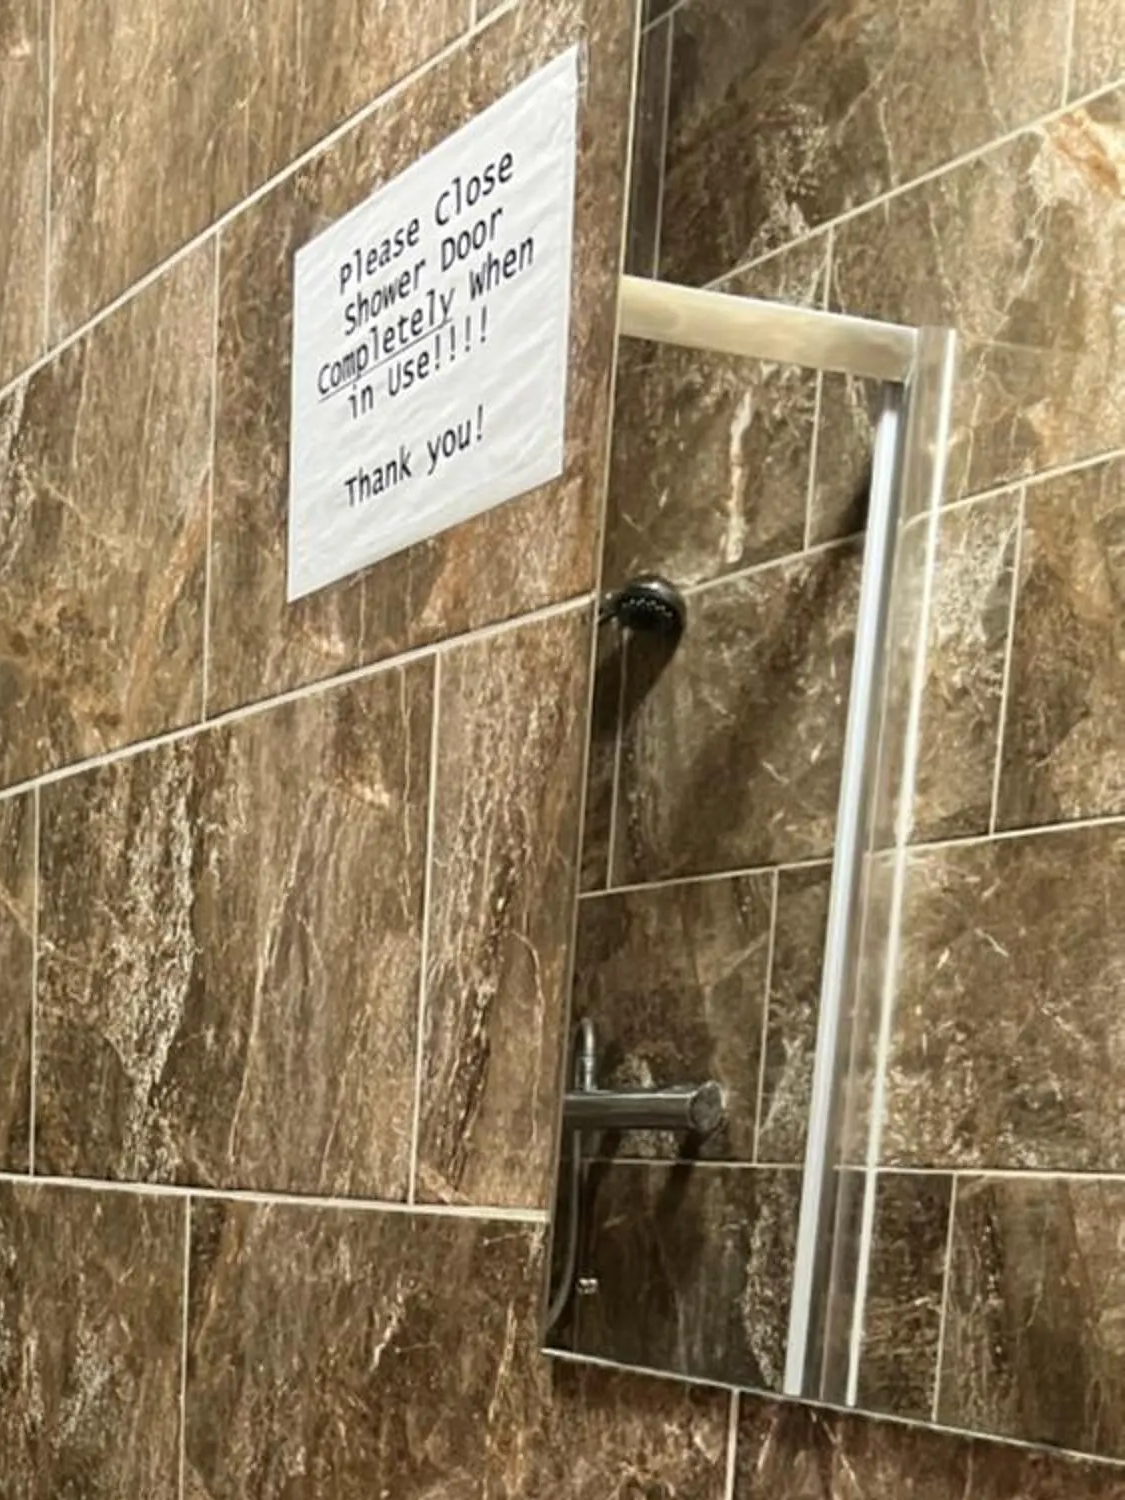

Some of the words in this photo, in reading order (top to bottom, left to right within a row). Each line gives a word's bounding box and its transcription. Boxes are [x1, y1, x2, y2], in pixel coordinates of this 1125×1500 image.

[338, 216, 420, 294] Please
[435, 151, 515, 226] Close
[345, 259, 426, 335] Shower
[441, 206, 505, 272] Door
[318, 286, 455, 395] Completely
[469, 235, 534, 300] When
[349, 384, 374, 420] in
[388, 306, 489, 396] Use!!!!
[345, 446, 412, 508] Thank
[427, 404, 484, 476] you!
